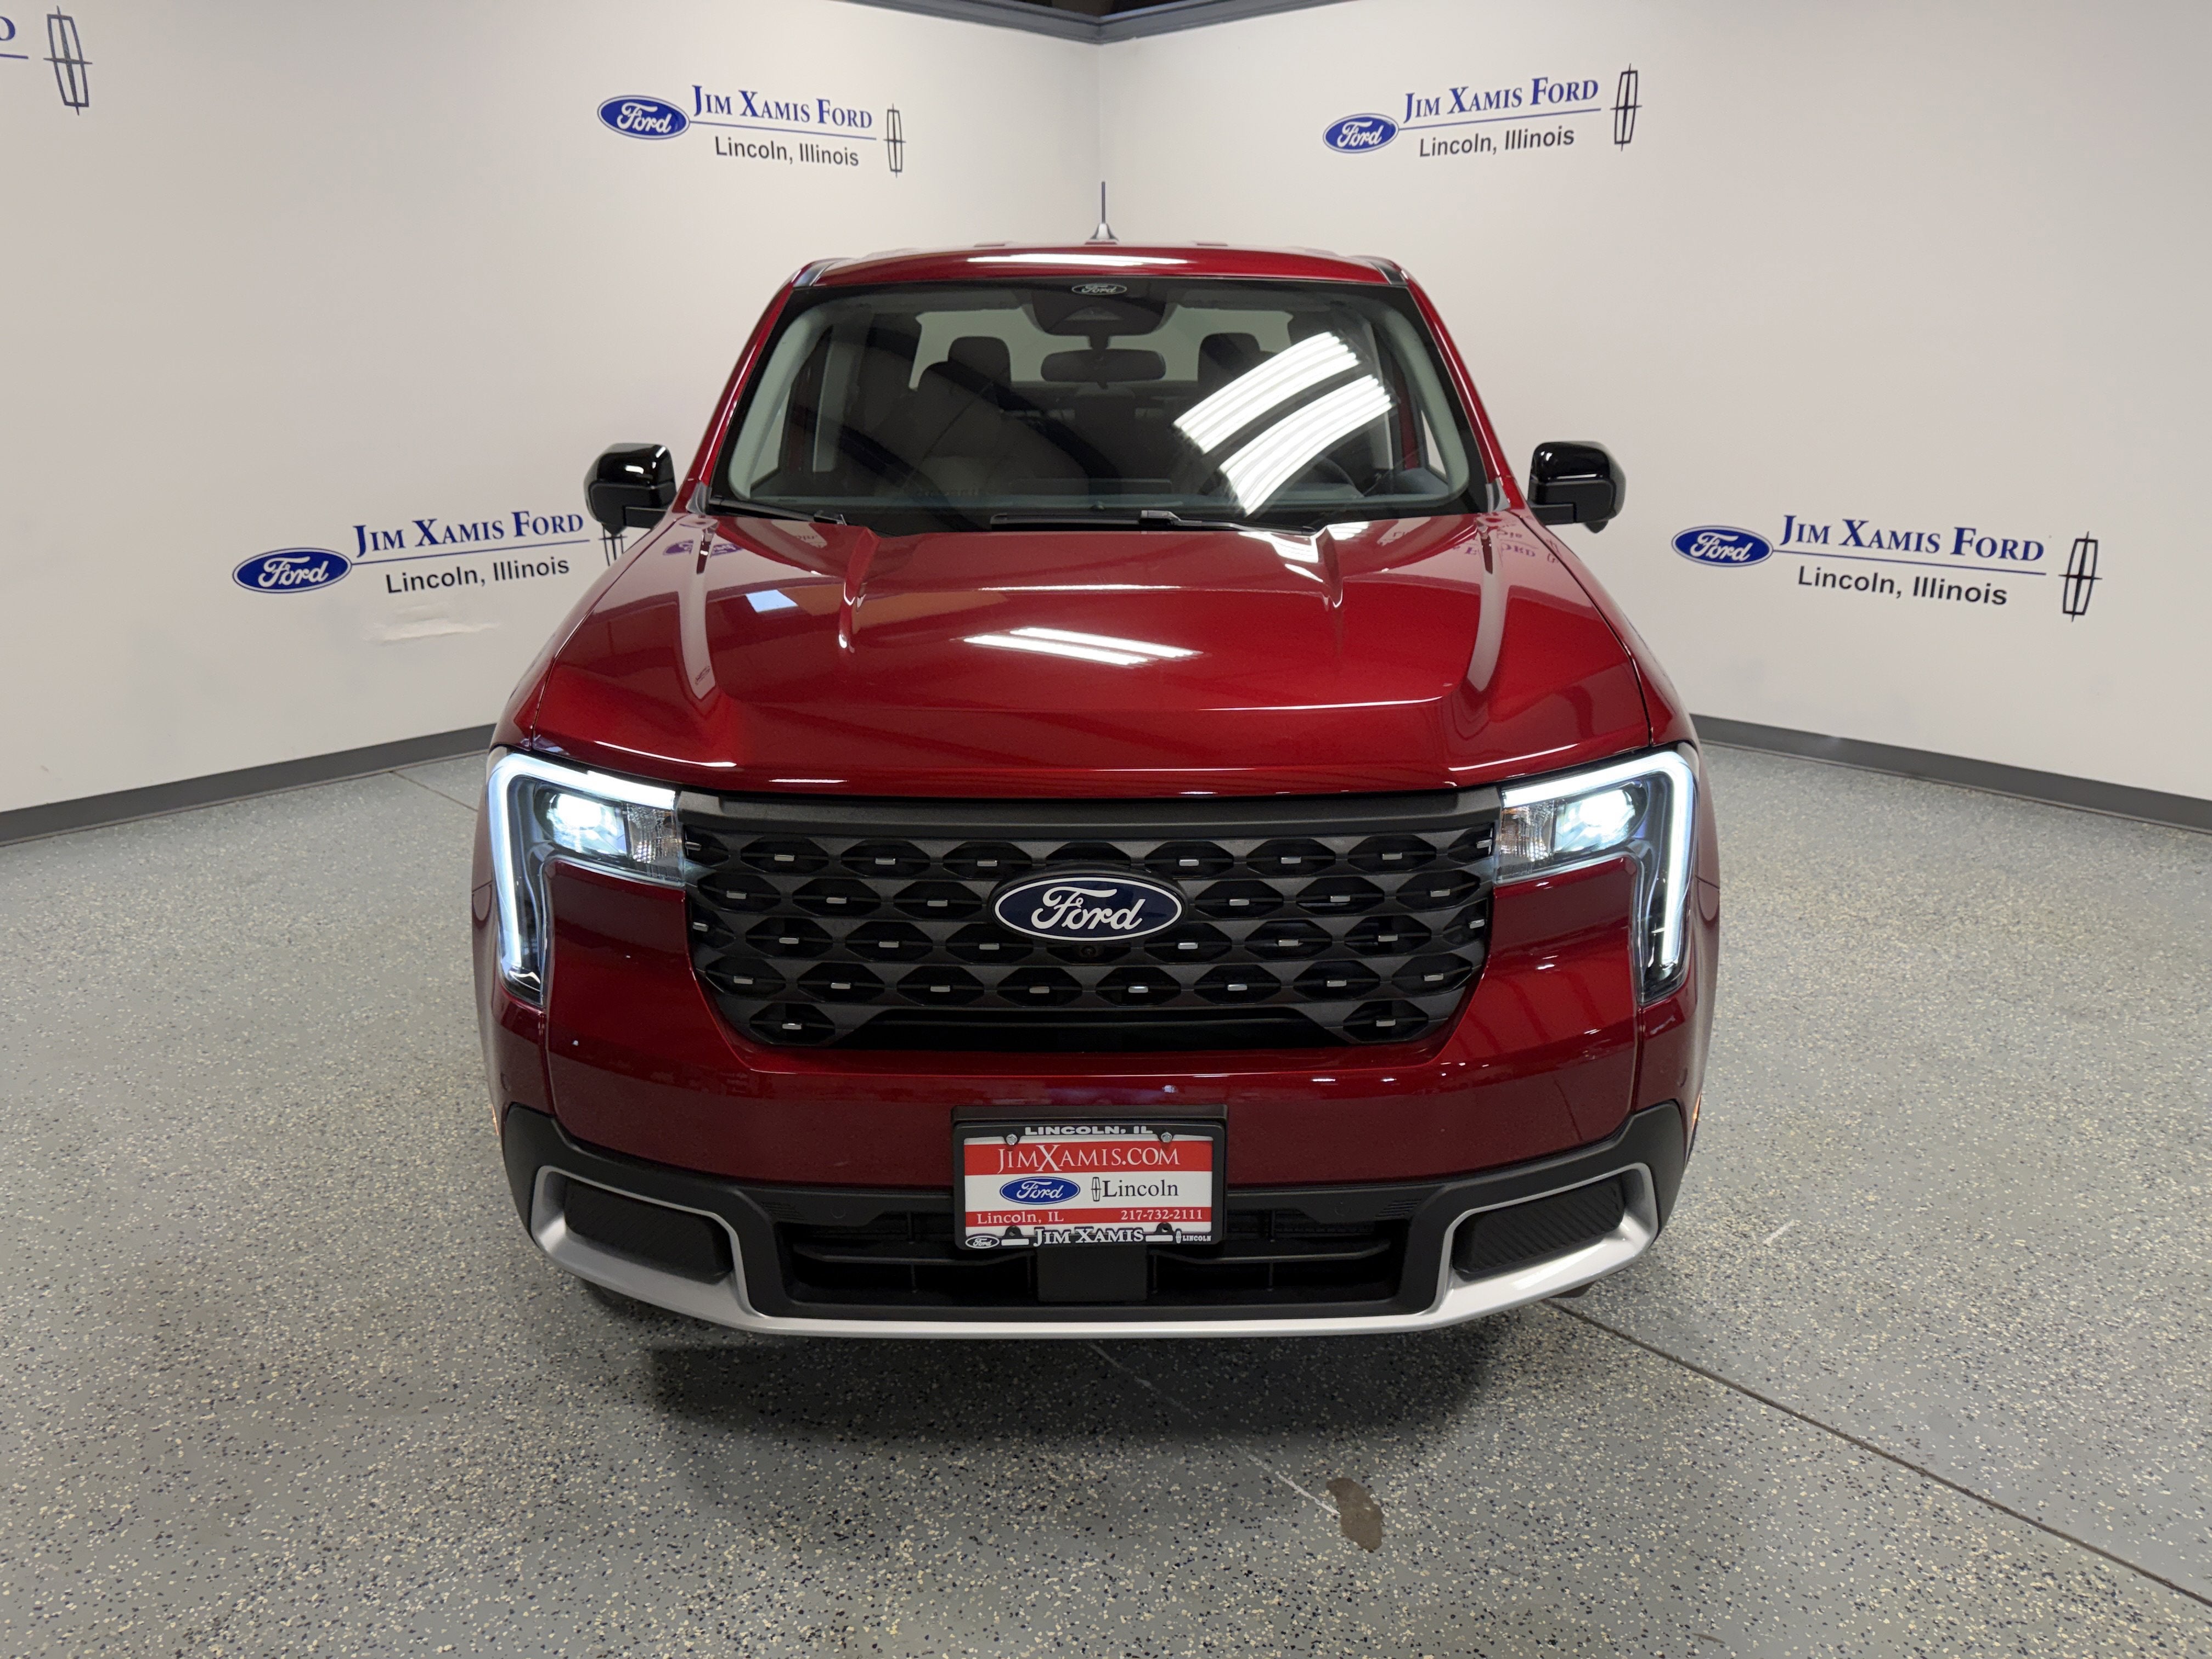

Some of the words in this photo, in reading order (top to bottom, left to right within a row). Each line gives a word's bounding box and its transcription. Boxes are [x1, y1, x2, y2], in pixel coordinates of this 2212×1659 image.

[692, 85, 732, 117] JIM
[738, 89, 810, 123] XAMIS
[816, 98, 872, 128] FORD
[1403, 93, 1441, 123] JIM
[1447, 86, 1523, 114] XAMIS
[1530, 77, 1599, 105] FORD
[715, 136, 793, 164] Lincoln,
[800, 143, 859, 166] Illinois
[1420, 133, 1497, 157] Lincoln,
[1505, 126, 1575, 150] Illinois
[353, 525, 406, 558] JIM
[412, 518, 505, 546] XAMIS
[511, 511, 584, 537] FORD
[1780, 515, 1831, 546] JIM
[1841, 518, 1941, 554] XAMIS
[1950, 527, 2044, 561] FORD
[386, 566, 484, 594] Lincoln,
[493, 557, 569, 581] Illinois
[1798, 566, 1902, 597] Lincoln,
[1912, 576, 2008, 605] Illinois
[1025, 1126, 1126, 1135] LINCOLN,
[1133, 1126, 1153, 1134] IL
[997, 1144, 1180, 1174] JIMXAMIS.COM
[1102, 1179, 1178, 1197] Lincoln
[977, 1211, 1041, 1224] Lincoln,
[1048, 1211, 1064, 1222] IL
[1120, 1210, 1203, 1221] 217-732-2111
[1034, 1228, 1071, 1247] JIM
[1076, 1228, 1144, 1243] XAMIS
